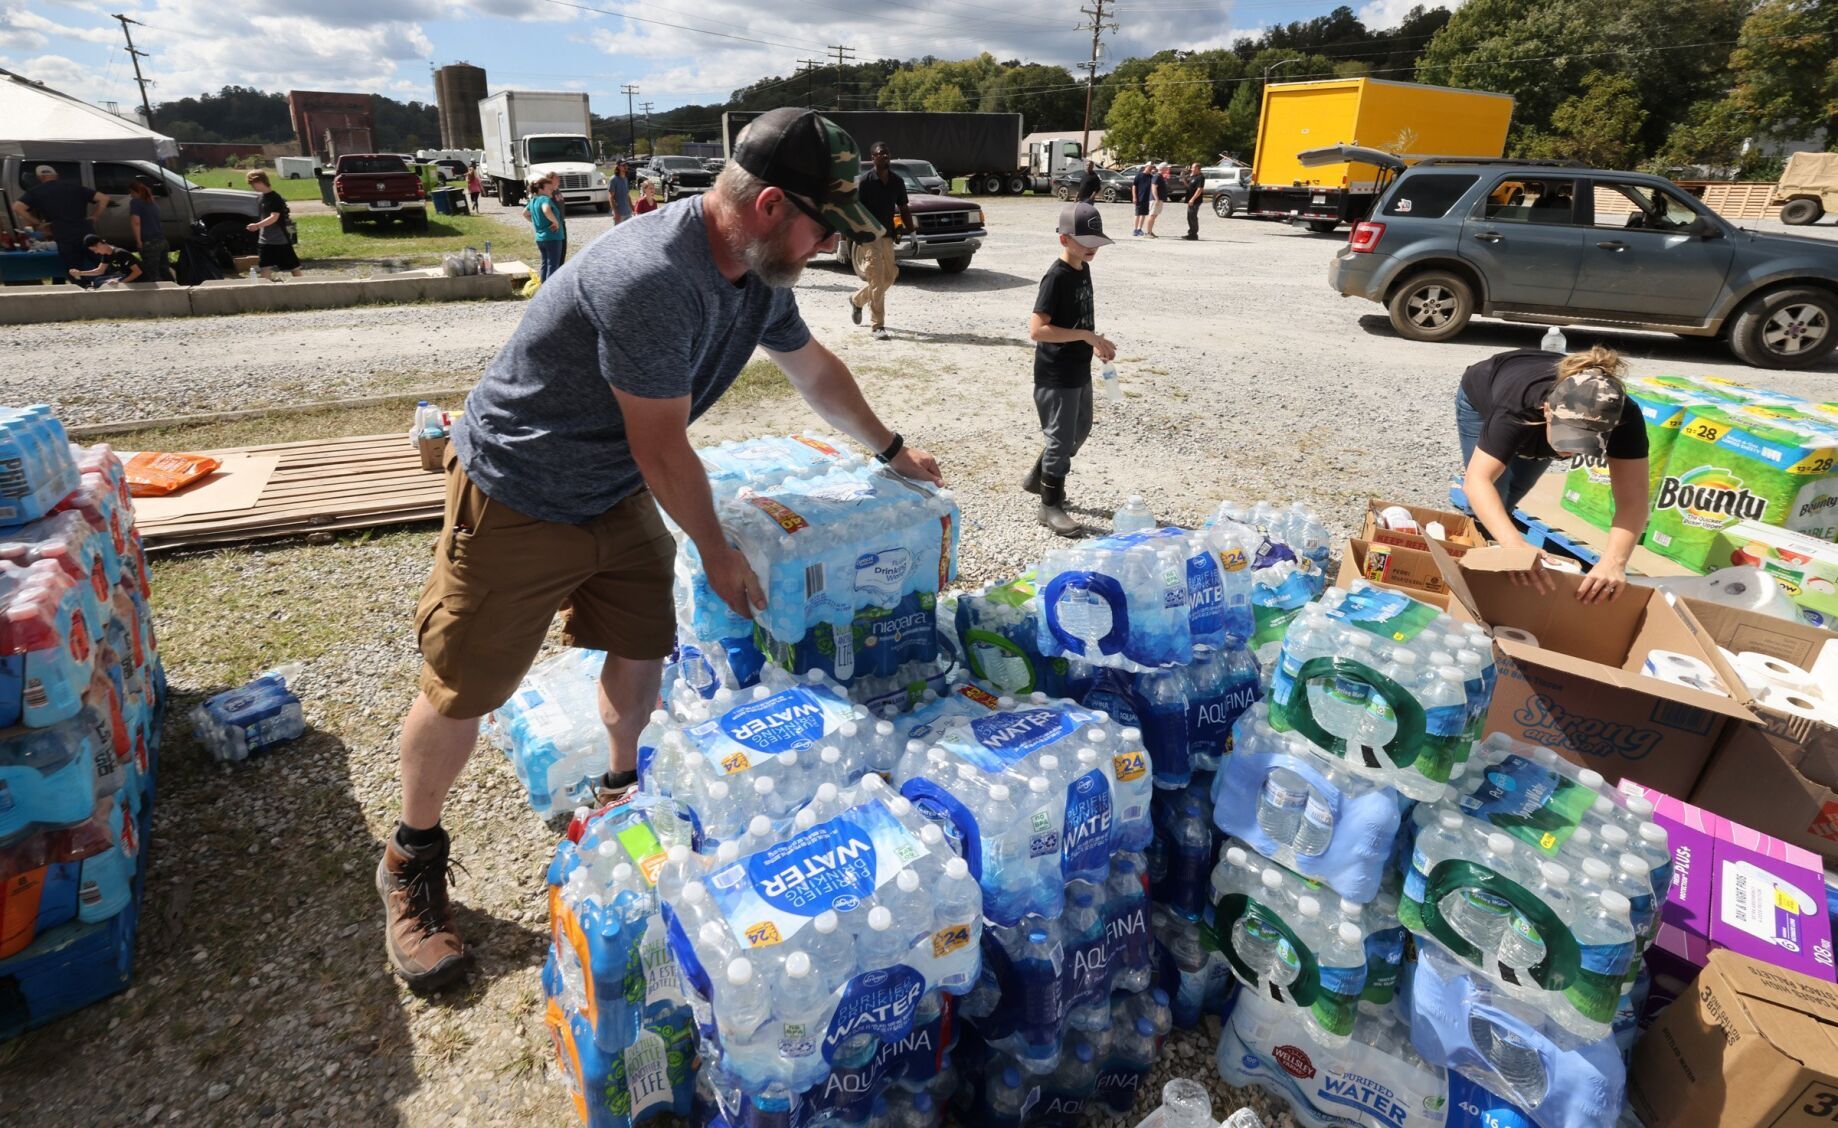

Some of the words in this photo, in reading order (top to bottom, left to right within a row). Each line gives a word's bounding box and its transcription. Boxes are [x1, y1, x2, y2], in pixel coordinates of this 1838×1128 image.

[1697, 425, 1717, 441] 28
[1812, 458, 1834, 472] 28
[1657, 477, 1766, 521] Bounty
[1229, 553, 1245, 564] 24
[873, 612, 926, 636] niagara
[731, 703, 821, 740] WATER
[982, 711, 1056, 748] WATER
[1513, 694, 1664, 761] Strong
[1523, 729, 1570, 746] and
[723, 758, 741, 771] 24
[1121, 756, 1145, 772] 24
[1067, 792, 1109, 818] PURIFIE
[1064, 812, 1111, 855] WATE
[760, 838, 871, 897] WATER
[785, 859, 867, 901] DRINKING
[748, 928, 770, 945] 24
[944, 928, 968, 945] 24
[1073, 909, 1147, 980] AQUFINA
[1813, 945, 1834, 967] 108
[827, 981, 921, 1046] WATER
[1700, 985, 1712, 1004] 3
[1711, 995, 1721, 1012] ONE
[1721, 1010, 1741, 1041] GALLON
[1706, 1001, 1735, 1047] BOTTLES
[824, 1030, 932, 1099] AQUAFINA
[1275, 1048, 1315, 1077] WELLSLEY
[633, 1071, 665, 1105] LIFE
[1325, 1076, 1407, 1124] WATER
[1342, 1072, 1394, 1098] PURIFIED
[1459, 1101, 1480, 1116] 40
